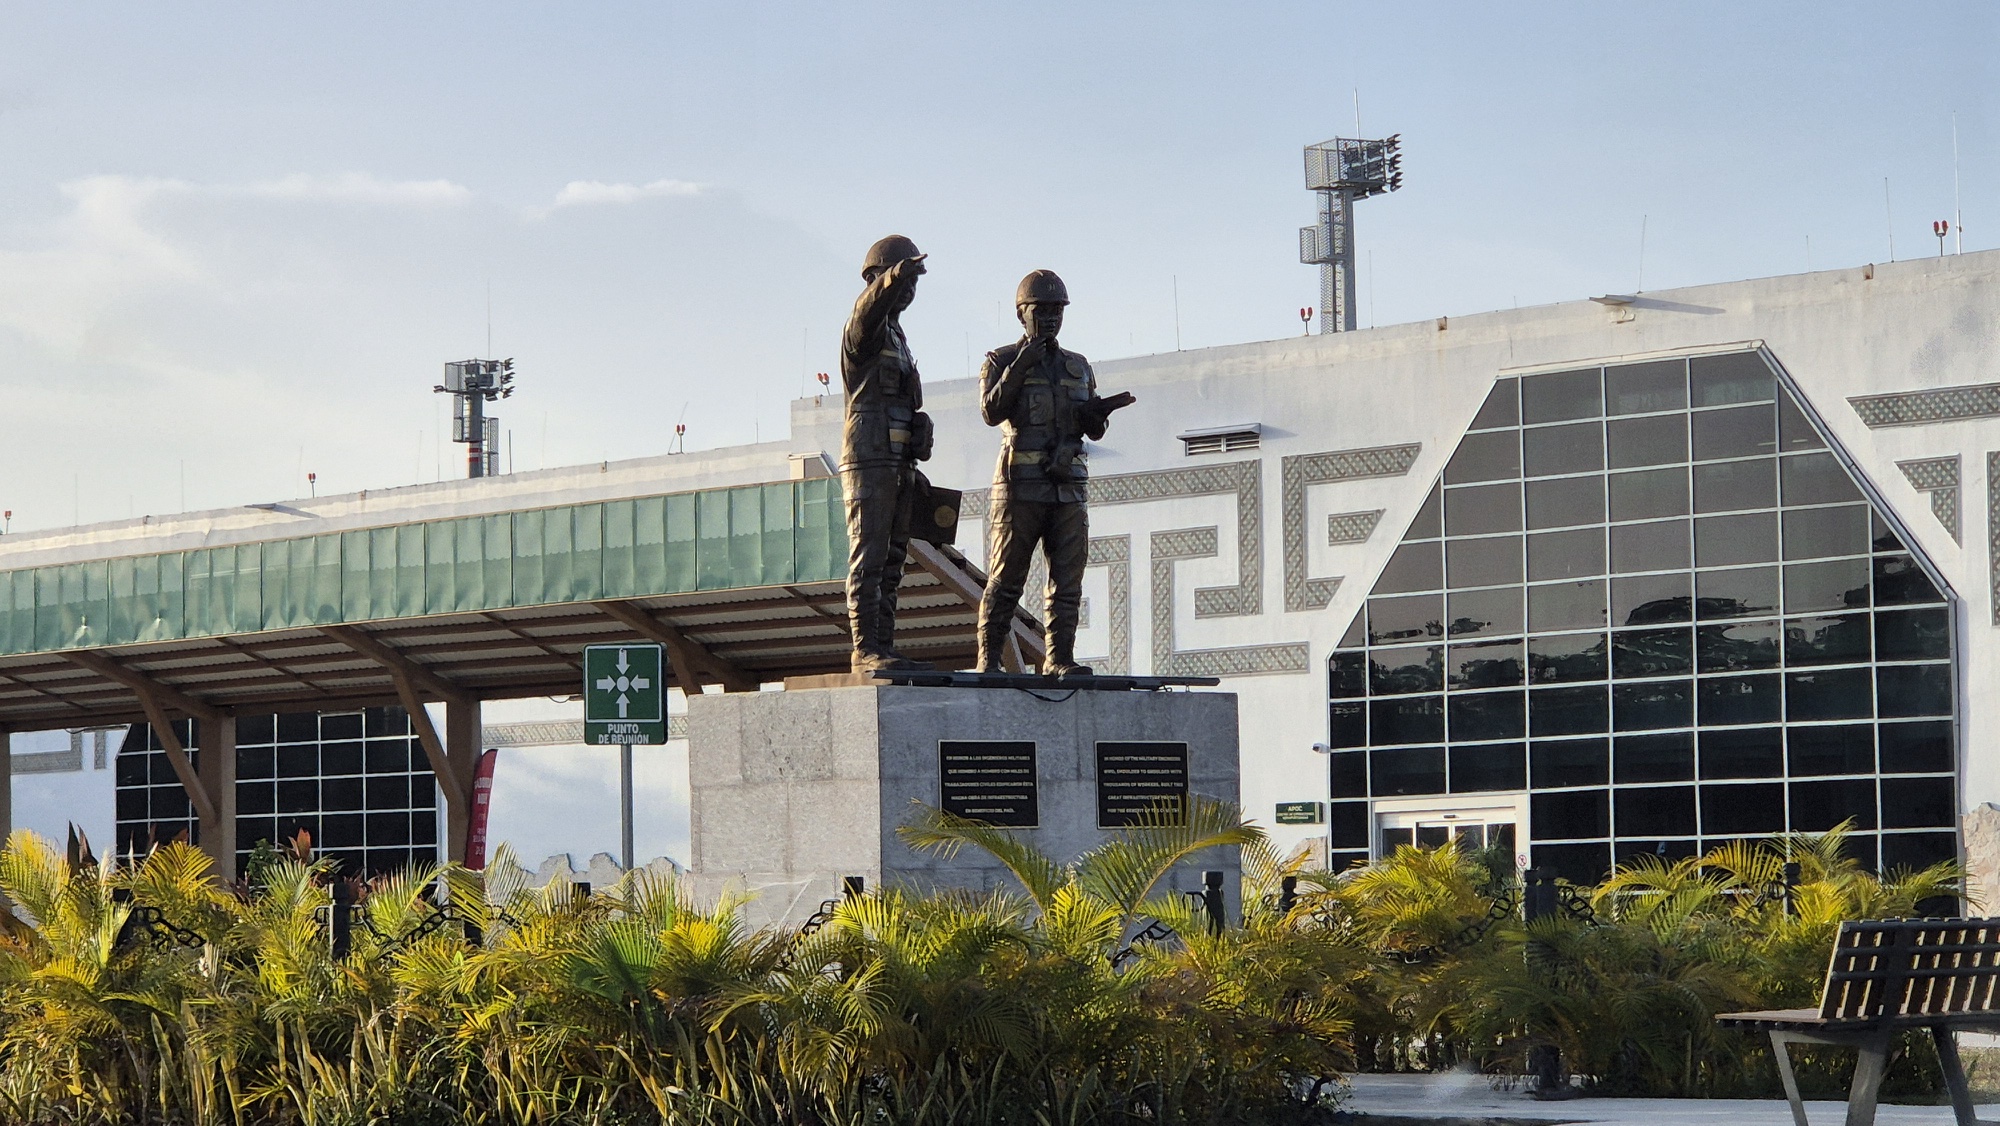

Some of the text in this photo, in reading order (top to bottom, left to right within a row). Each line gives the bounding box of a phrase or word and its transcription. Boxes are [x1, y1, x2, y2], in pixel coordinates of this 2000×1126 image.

[607, 723, 639, 734] PUNTO
[598, 731, 650, 745] DE REUNIÓN
